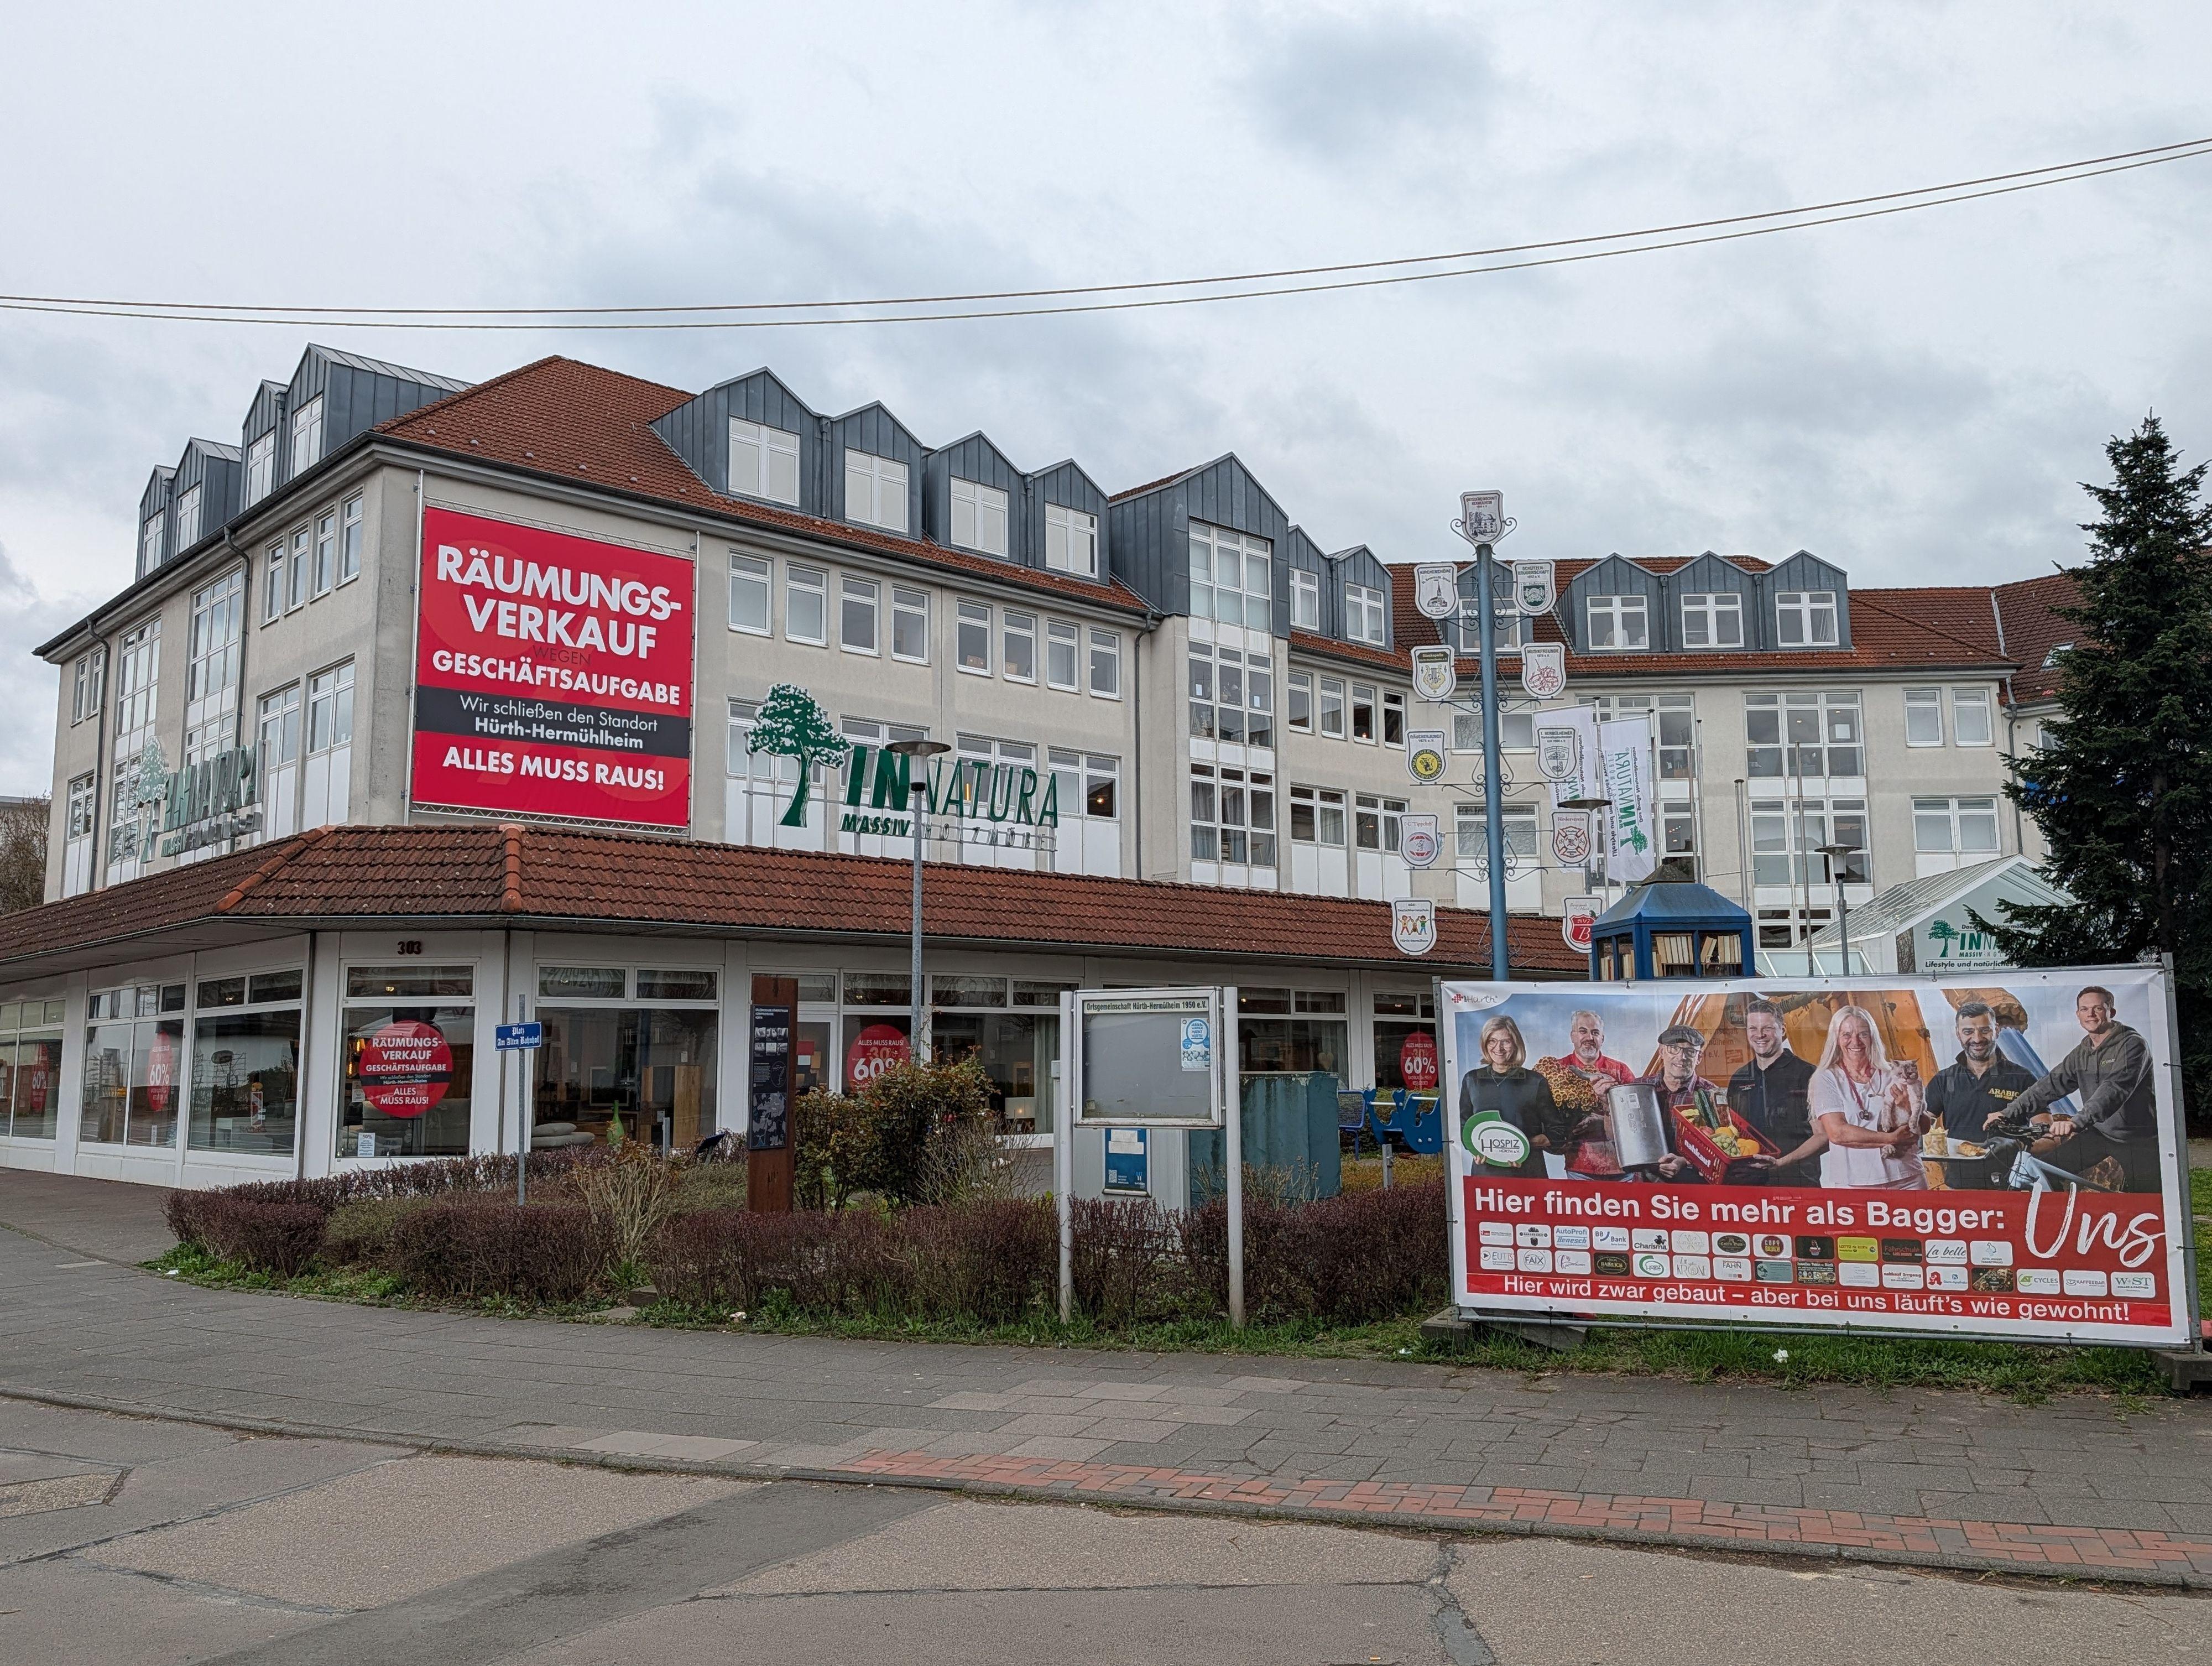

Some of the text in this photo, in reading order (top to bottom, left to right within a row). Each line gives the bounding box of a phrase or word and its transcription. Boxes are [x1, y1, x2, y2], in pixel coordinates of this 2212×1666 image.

[437, 545, 681, 620] RÄUMUNGS-
[463, 595, 656, 659] VERKAUF
[533, 645, 591, 667] WEGEN
[432, 650, 680, 705] GESCHÄFTSAUFGABE
[460, 695, 658, 731] Wir schließen den Standort
[475, 717, 643, 748] Hürth-Hermühlheim
[442, 747, 664, 790] ALLES MUSS RAUS!
[846, 745, 1058, 829] INNATURA
[841, 813, 911, 837] MASSIV
[1578, 927, 1590, 940] B
[397, 940, 421, 955] 303
[1087, 1000, 1207, 1012] Ortsgemeinschaft Hürth-Hermülheim 1950 e.V.
[373, 1037, 442, 1048] RÄUMUNGS-
[512, 1027, 524, 1036] Platz
[520, 1035, 539, 1045] Bahnhof
[382, 1050, 432, 1060] VERKAUF
[1405, 1056, 1436, 1074] 60%
[150, 1064, 169, 1086] 60%
[366, 1063, 446, 1072] GESCHÄFTSAUFGABE
[32, 1071, 46, 1089] 60%
[1481, 1139, 1520, 1152] HOSPIZ
[1684, 1139, 1712, 1168] nahkauf
[1475, 1182, 2166, 1268] Hier finden Sie mehr als Bagger: Uns
[1926, 1245, 1966, 1258] La belle
[1504, 1275, 1544, 1294] Hier
[1550, 1279, 1591, 1297] wird
[1598, 1284, 1646, 1299] zwar
[1653, 1284, 1726, 1303] gebaut
[1751, 1287, 1799, 1305] aber
[1806, 1289, 1839, 1307] bei
[1847, 1295, 1887, 1309] uns
[1970, 1298, 2010, 1316] wie
[2018, 1301, 2130, 1321] gewohnt!
